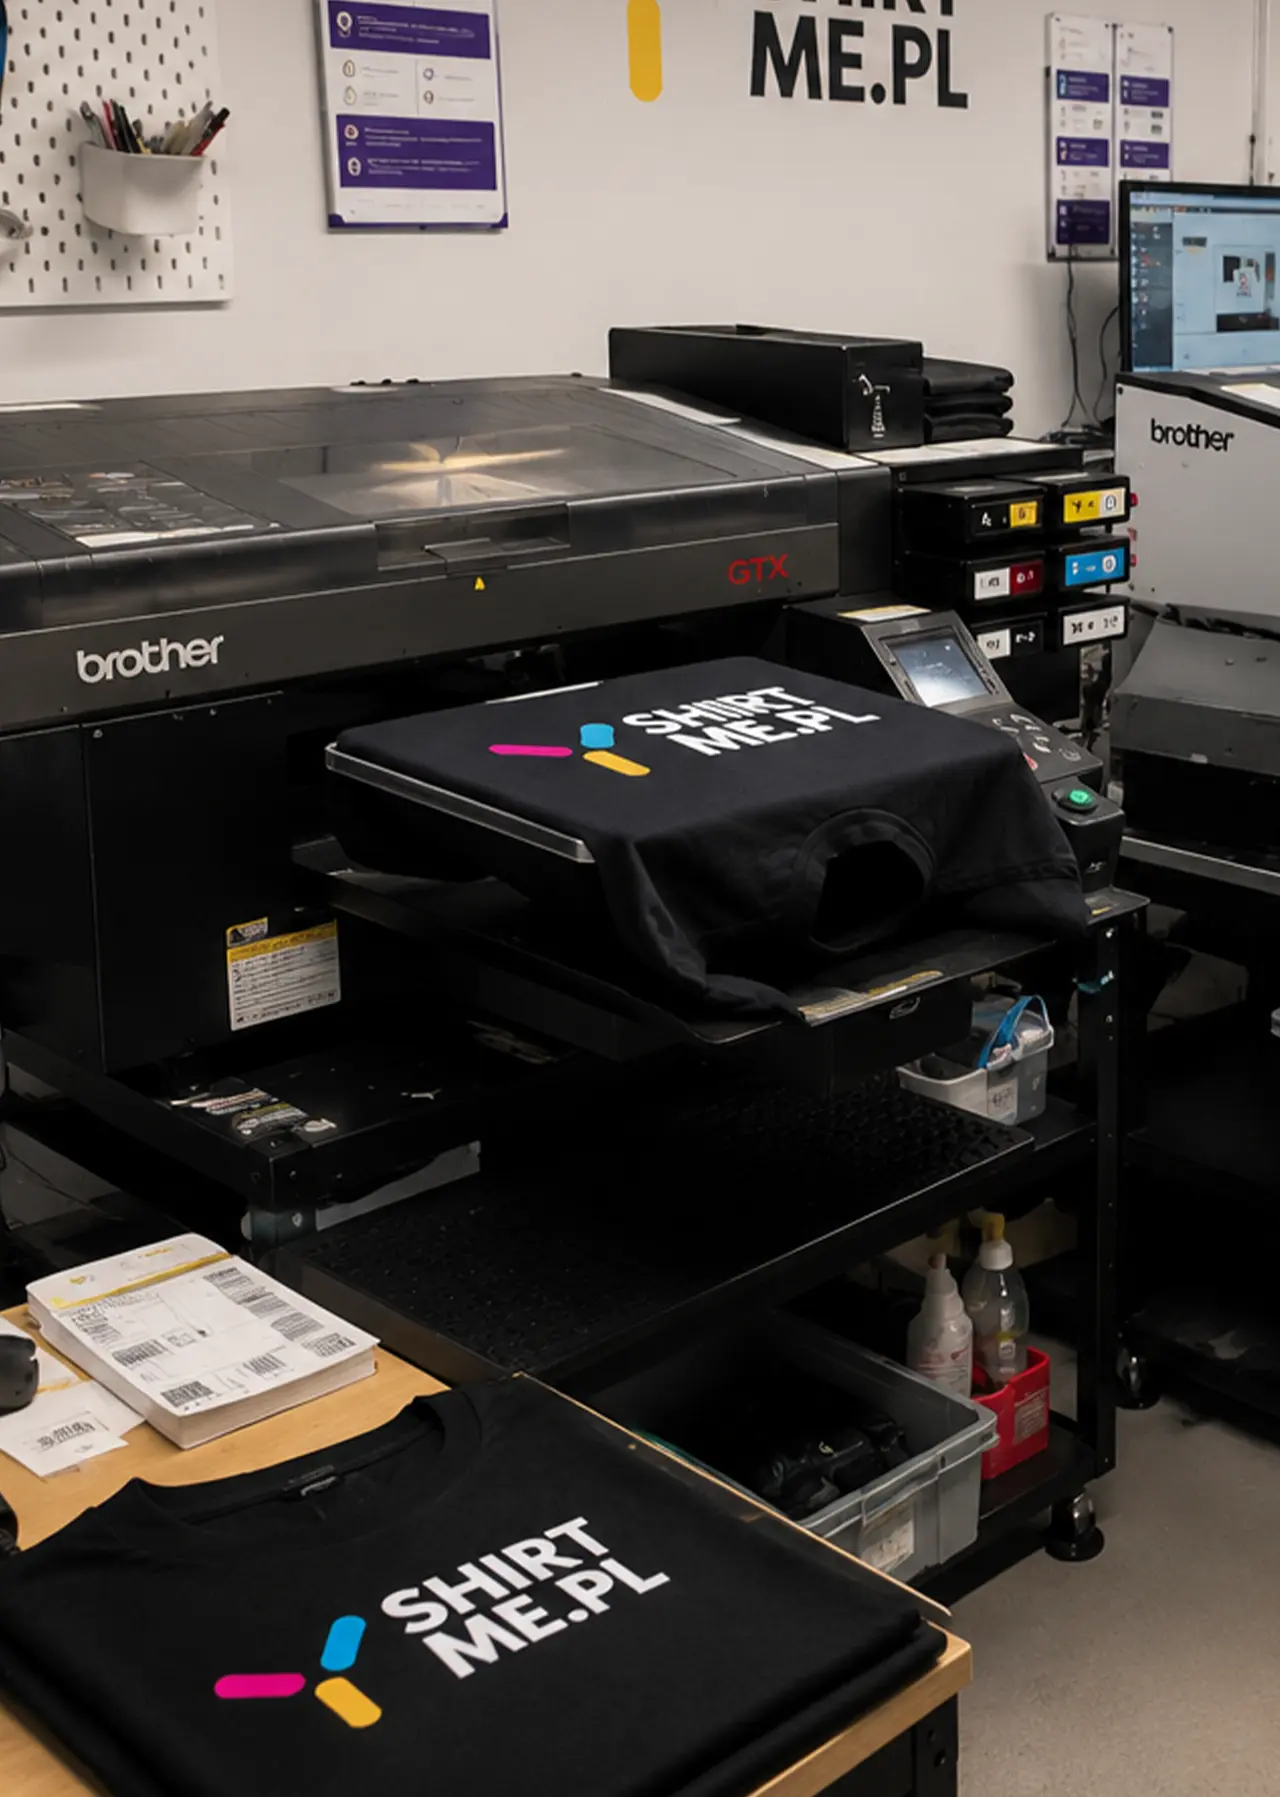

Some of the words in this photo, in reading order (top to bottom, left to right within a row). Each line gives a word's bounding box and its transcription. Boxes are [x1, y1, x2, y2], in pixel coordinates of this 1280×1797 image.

[750, 10, 969, 109] ME.PL
[1151, 418, 1234, 452] brother
[727, 552, 788, 585] GTX
[76, 635, 224, 683] brother
[666, 706, 882, 757] ME.PL
[381, 1516, 610, 1634] SHIRT
[422, 1557, 671, 1680] ME.PL
